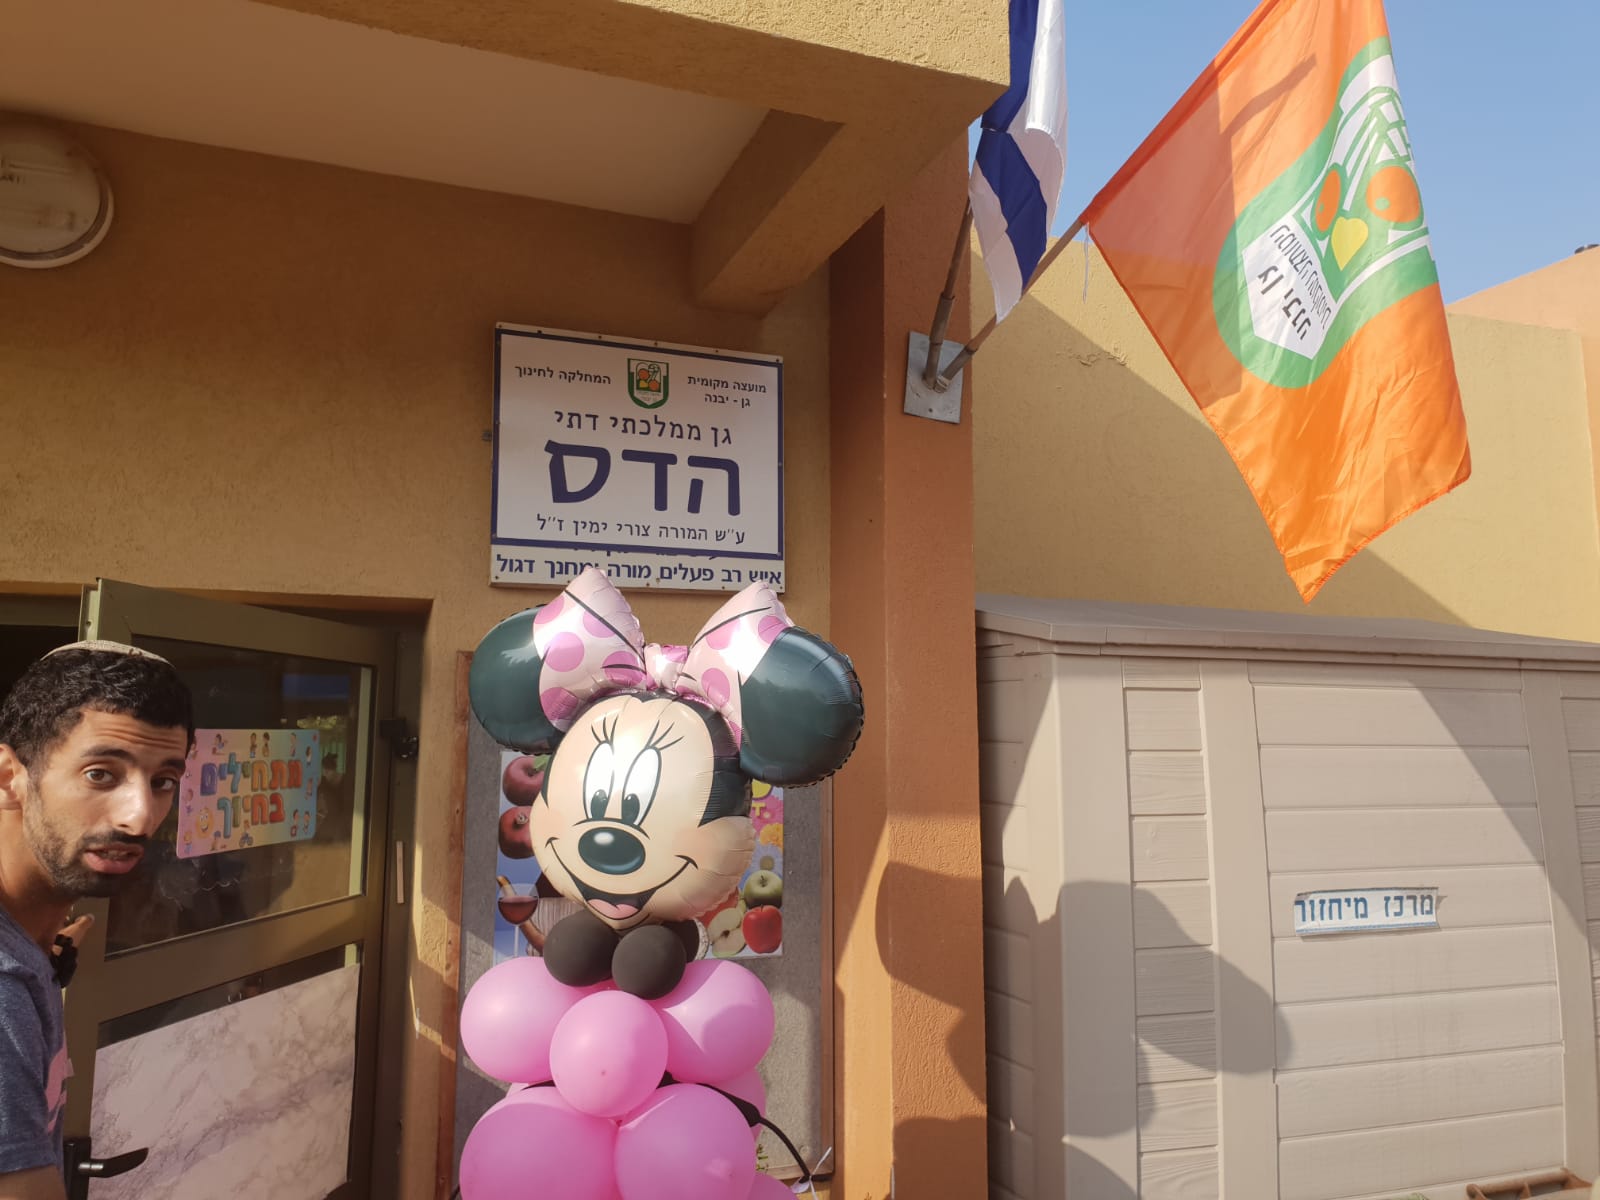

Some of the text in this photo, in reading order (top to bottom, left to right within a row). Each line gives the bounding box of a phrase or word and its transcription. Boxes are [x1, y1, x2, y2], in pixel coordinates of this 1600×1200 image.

[514, 364, 611, 385] המחלקה לחינוך
[688, 374, 767, 394] מועצה מקומית
[704, 392, 729, 405] יבנה
[741, 396, 751, 408] גן
[554, 410, 732, 447] גן ממלכתי דתי
[544, 439, 741, 517] הדס
[573, 519, 608, 535] ימין
[616, 522, 651, 537] צורי
[658, 525, 708, 541] המורה
[496, 554, 536, 574] דגול
[607, 562, 651, 578] מורה
[659, 563, 715, 584] פעלים
[721, 567, 742, 582] רב
[201, 752, 303, 796] מתחילים
[217, 792, 285, 839] בחיוך
[1294, 894, 1434, 922] מרכז מיחזור
